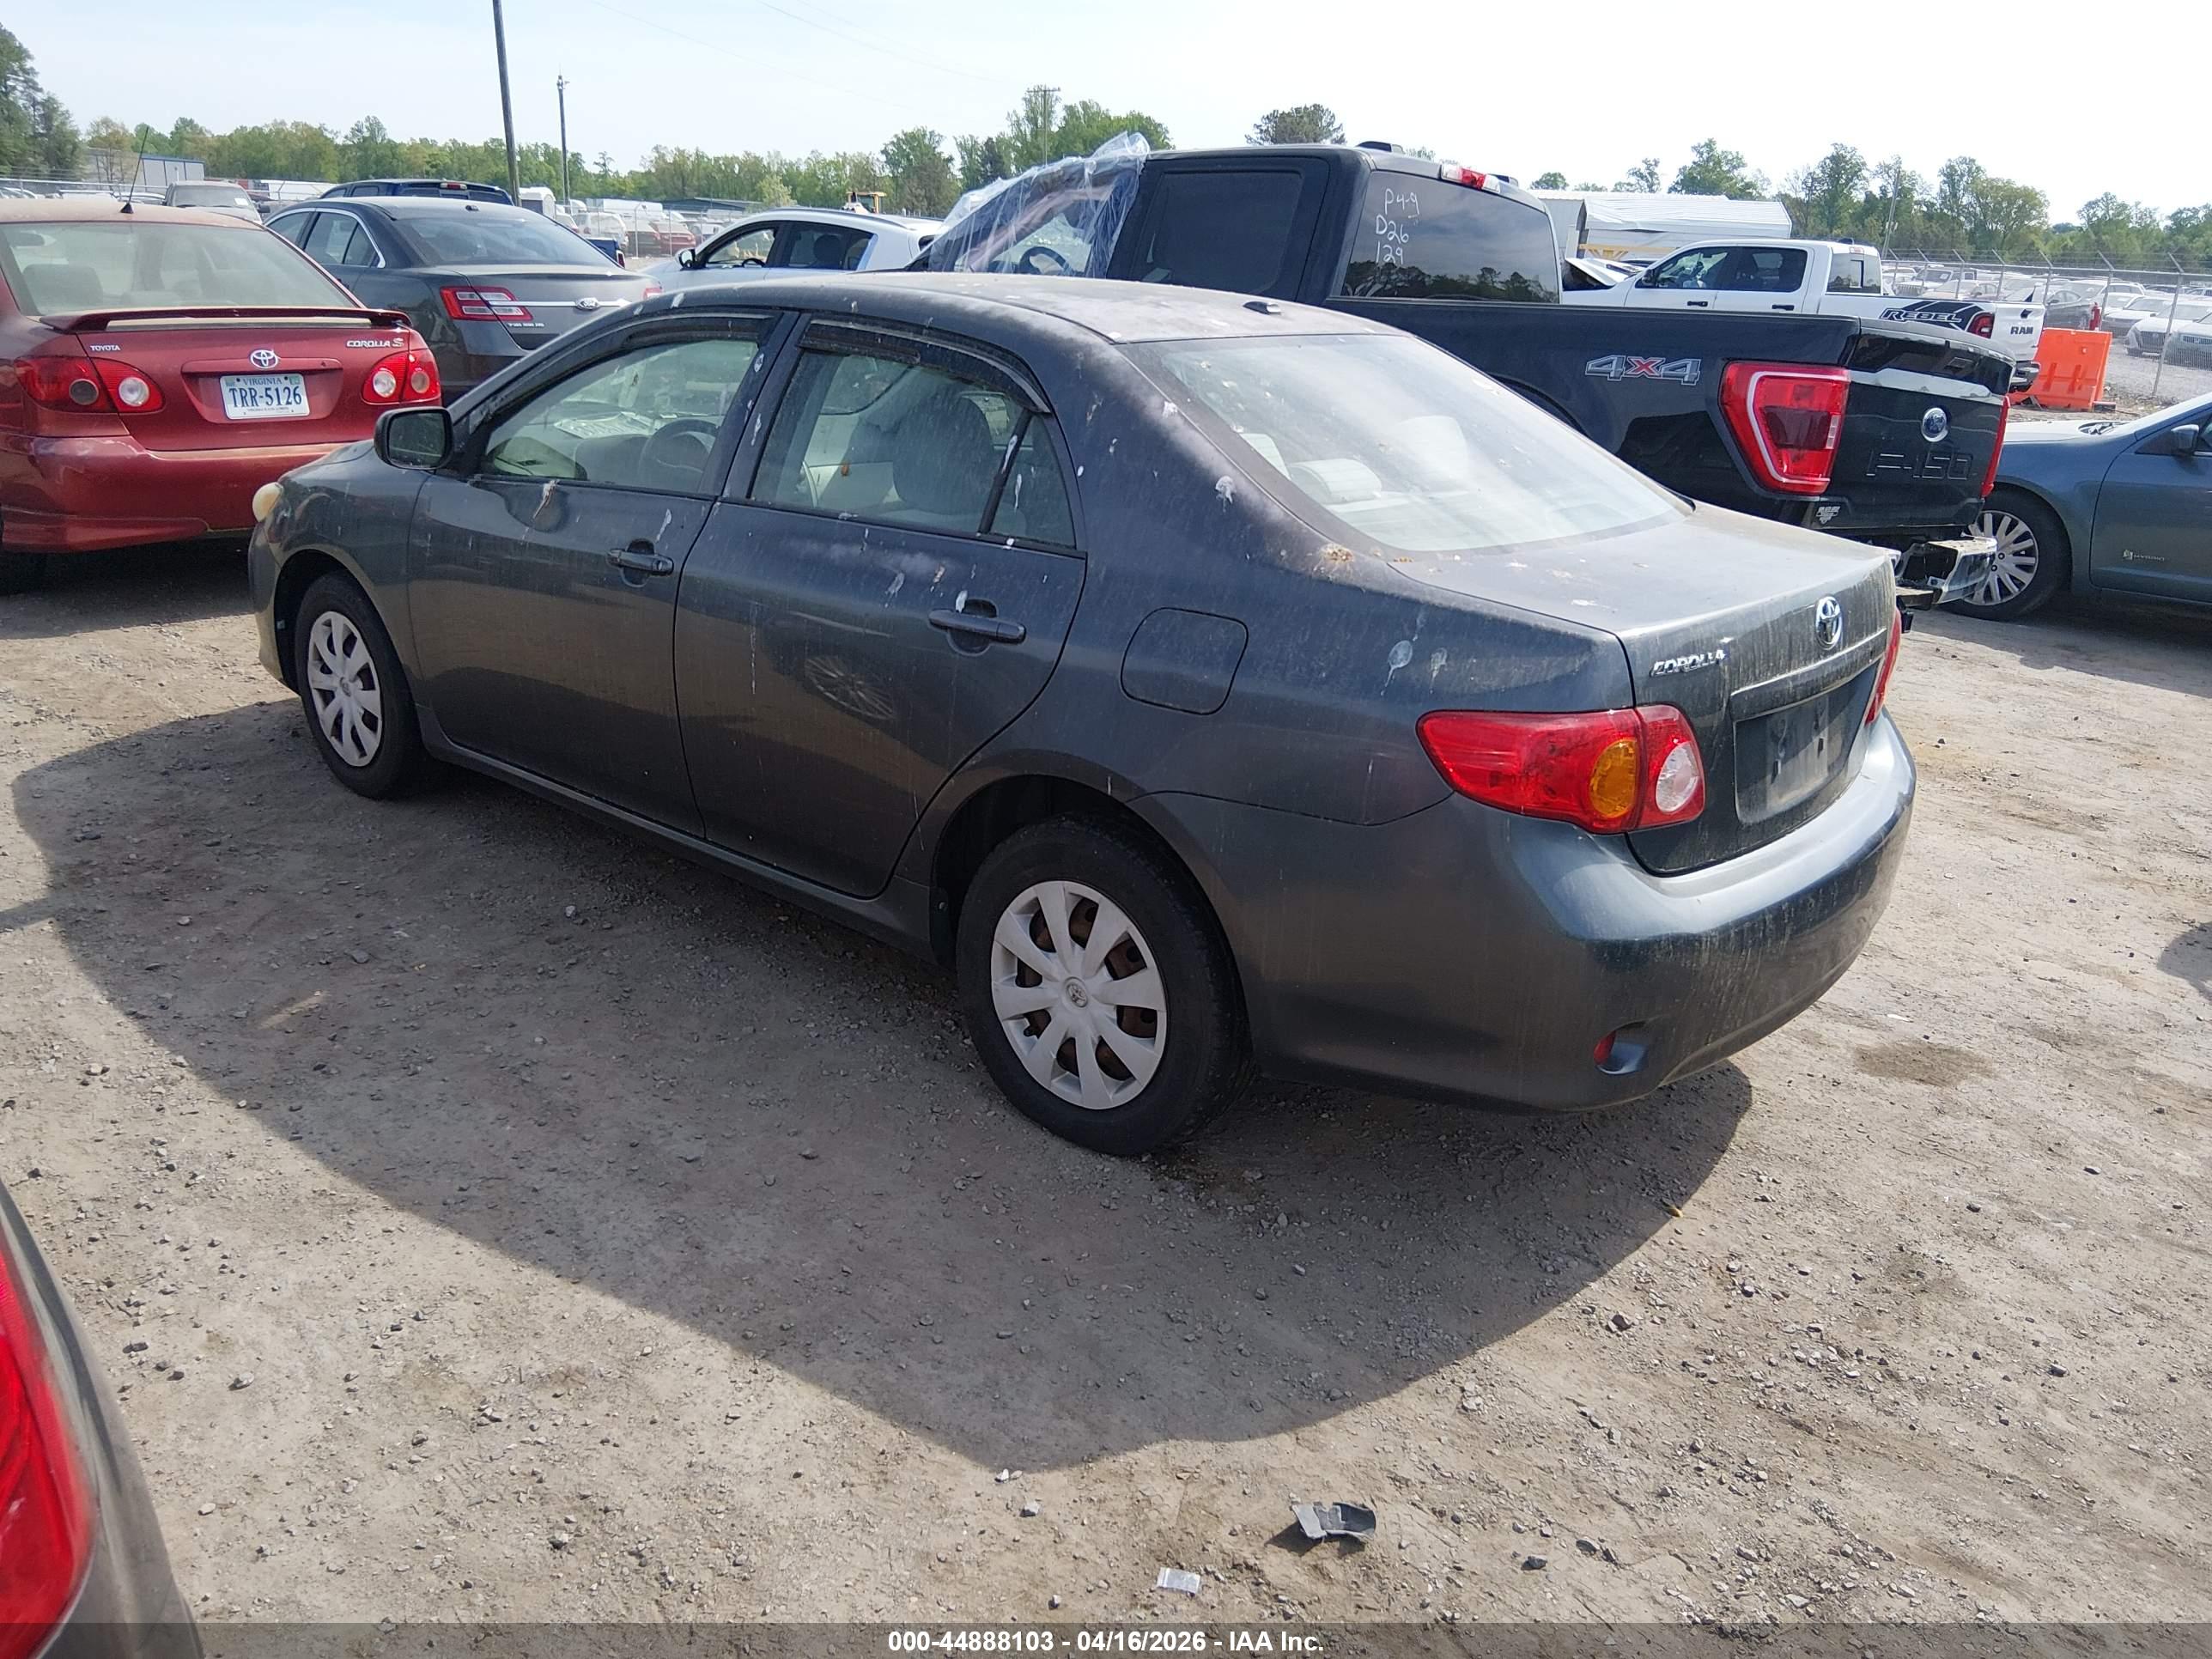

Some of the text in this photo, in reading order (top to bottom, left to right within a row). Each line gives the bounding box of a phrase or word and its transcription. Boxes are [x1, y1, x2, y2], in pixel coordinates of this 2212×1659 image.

[1375, 214, 1409, 245] D26
[1376, 240, 1403, 265] 129
[1878, 307, 1963, 323] REBEL
[2009, 325, 2034, 336] RAM
[346, 337, 404, 349] COROLLA S
[242, 377, 283, 386] VIRGINIA
[228, 386, 302, 408] TRR-5126
[1865, 449, 1973, 481] F-150
[1649, 648, 1726, 678] COROLLA
